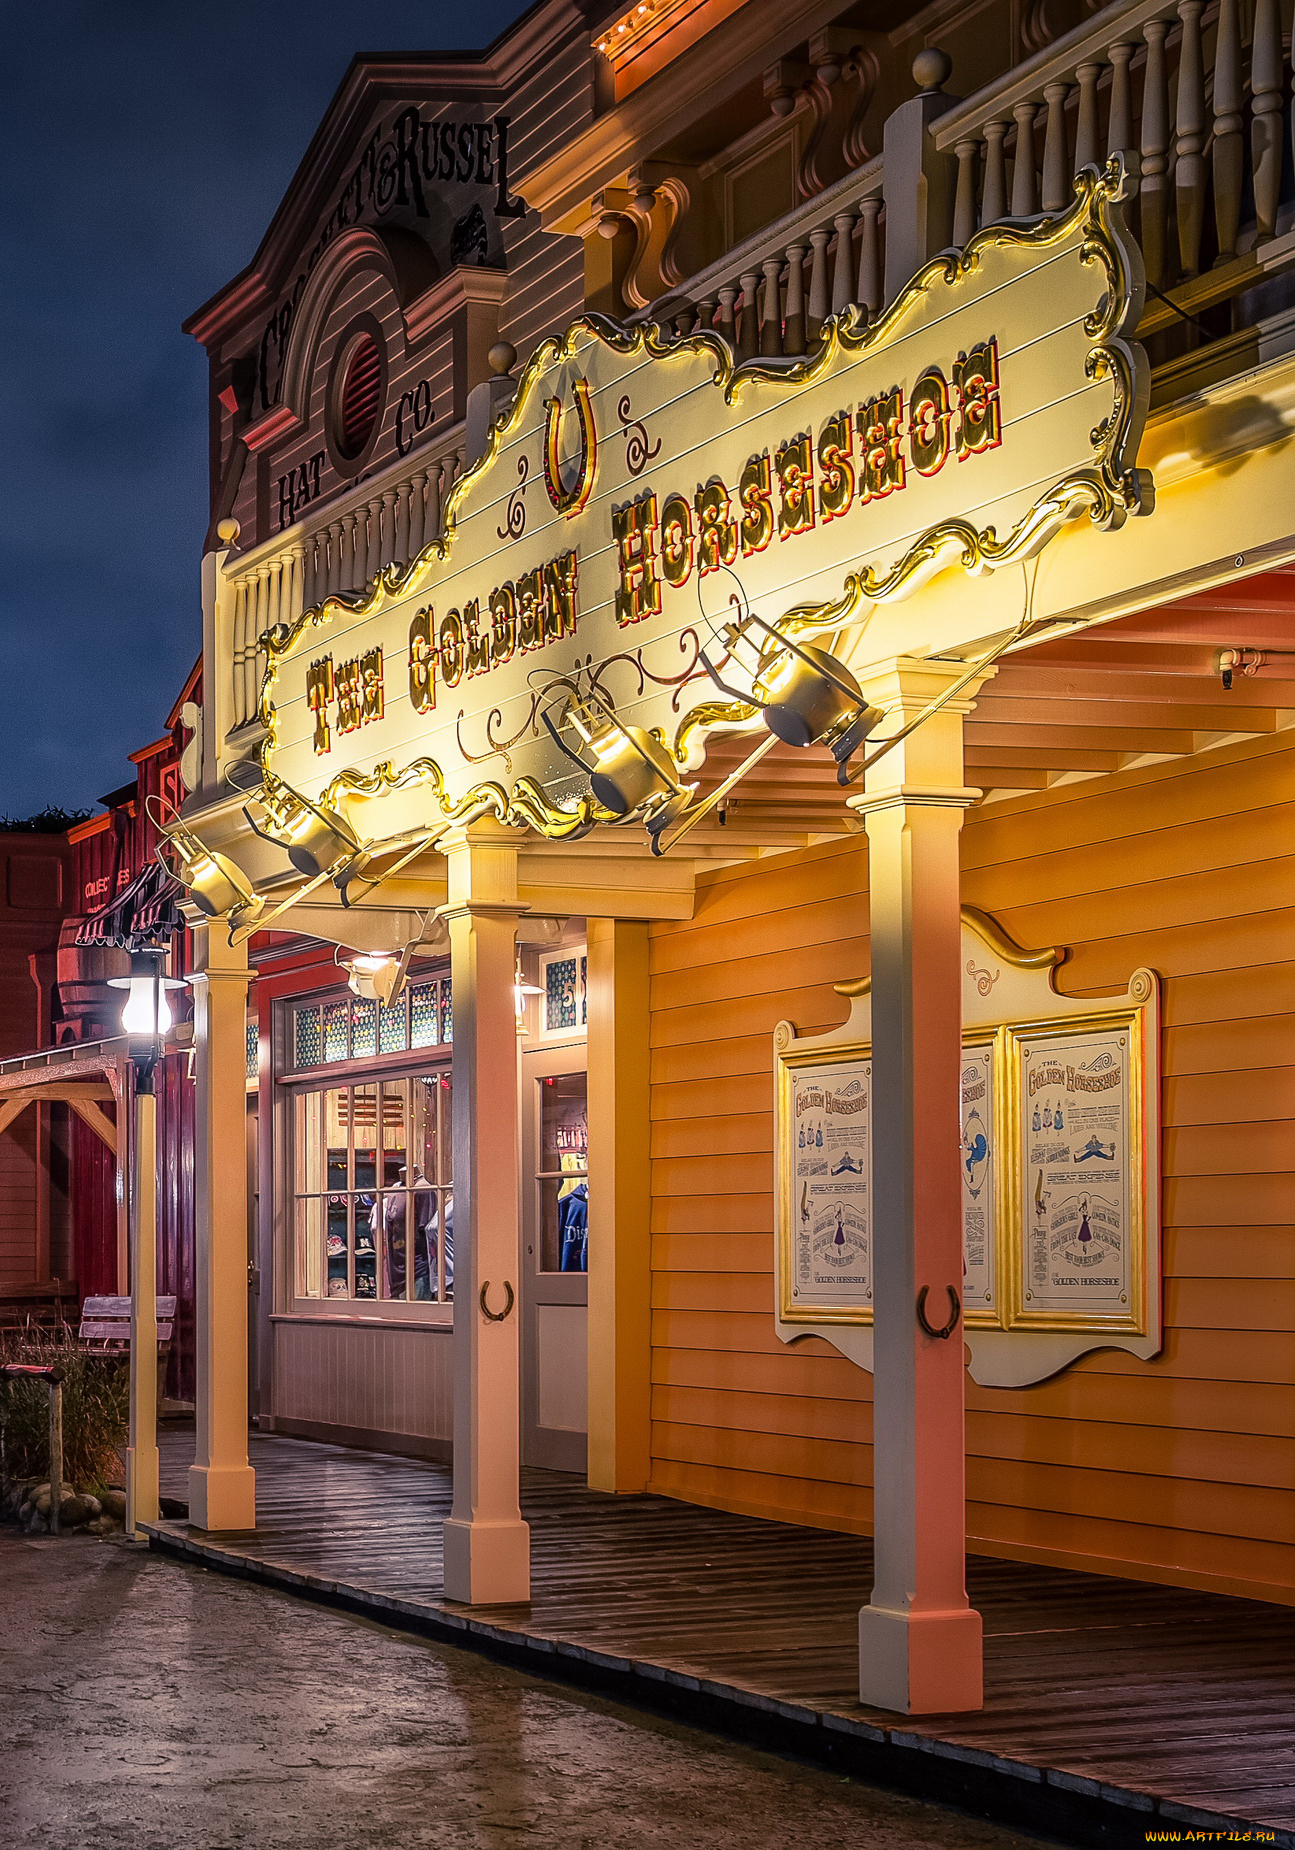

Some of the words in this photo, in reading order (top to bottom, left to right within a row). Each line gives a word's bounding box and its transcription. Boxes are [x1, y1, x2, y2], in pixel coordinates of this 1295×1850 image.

[277, 449, 326, 531] HAT
[395, 379, 435, 458] CO.
[306, 648, 385, 756] THE
[409, 550, 578, 715] GOLDEN
[612, 340, 1002, 628] HORSESHOE
[1029, 1068, 1065, 1097] GOLDEN
[1066, 1065, 1121, 1093] HORSESHOE
